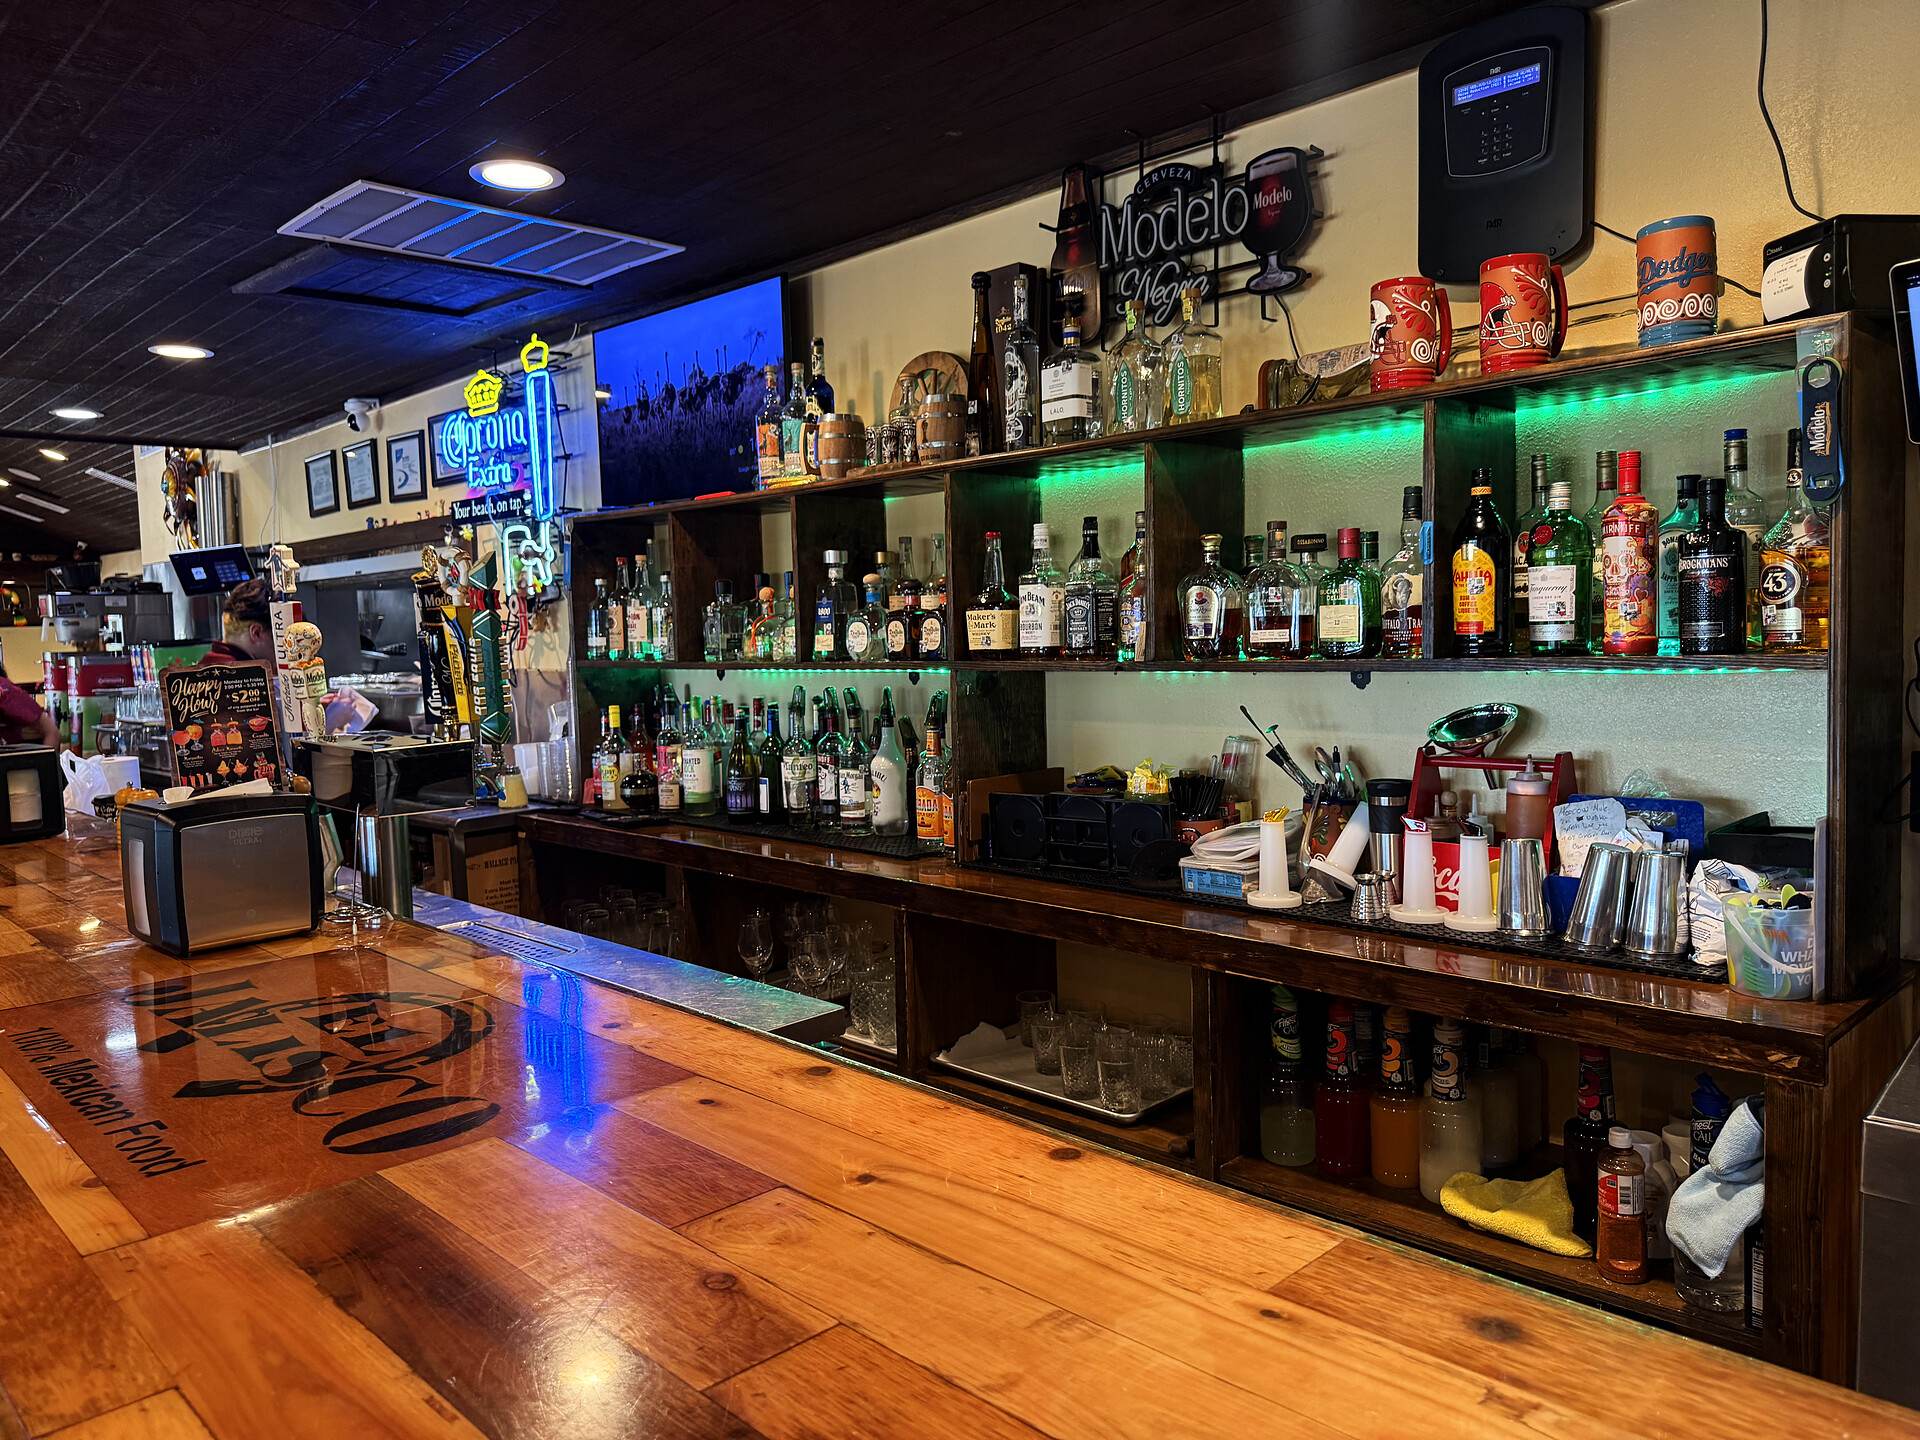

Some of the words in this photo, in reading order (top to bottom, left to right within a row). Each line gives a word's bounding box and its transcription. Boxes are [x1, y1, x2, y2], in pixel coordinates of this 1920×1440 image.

[1136, 167, 1192, 195] CERVEZA
[1253, 186, 1292, 211] Modelo
[1100, 178, 1249, 269] Modelo
[1049, 406, 1064, 415] LALO
[442, 411, 528, 469] Corona
[1809, 409, 1826, 451] Modelo
[468, 455, 512, 488] Extra
[453, 503, 471, 520] Your
[472, 500, 496, 517] beach,
[497, 502, 508, 511] on
[509, 499, 524, 516] tap.
[1679, 557, 1729, 570] BROCKMANS
[1529, 583, 1568, 594] Tanqueray
[1763, 571, 1787, 592] 43
[1027, 592, 1045, 606] BEAM
[967, 613, 996, 621] Maker's
[1382, 619, 1400, 630] UFFALO
[274, 610, 287, 660] ULTRA
[469, 637, 482, 683] EQUIS
[170, 677, 222, 706] Happy
[177, 691, 219, 723] Hour
[473, 685, 482, 716] DOS
[8, 1026, 81, 1063] 100%
[300, 1001, 432, 1057] EL
[122, 979, 501, 1155] JALISCO
[37, 1057, 135, 1126] Mexican
[103, 1119, 208, 1178] Food
[1693, 1130, 1714, 1144] CALL
